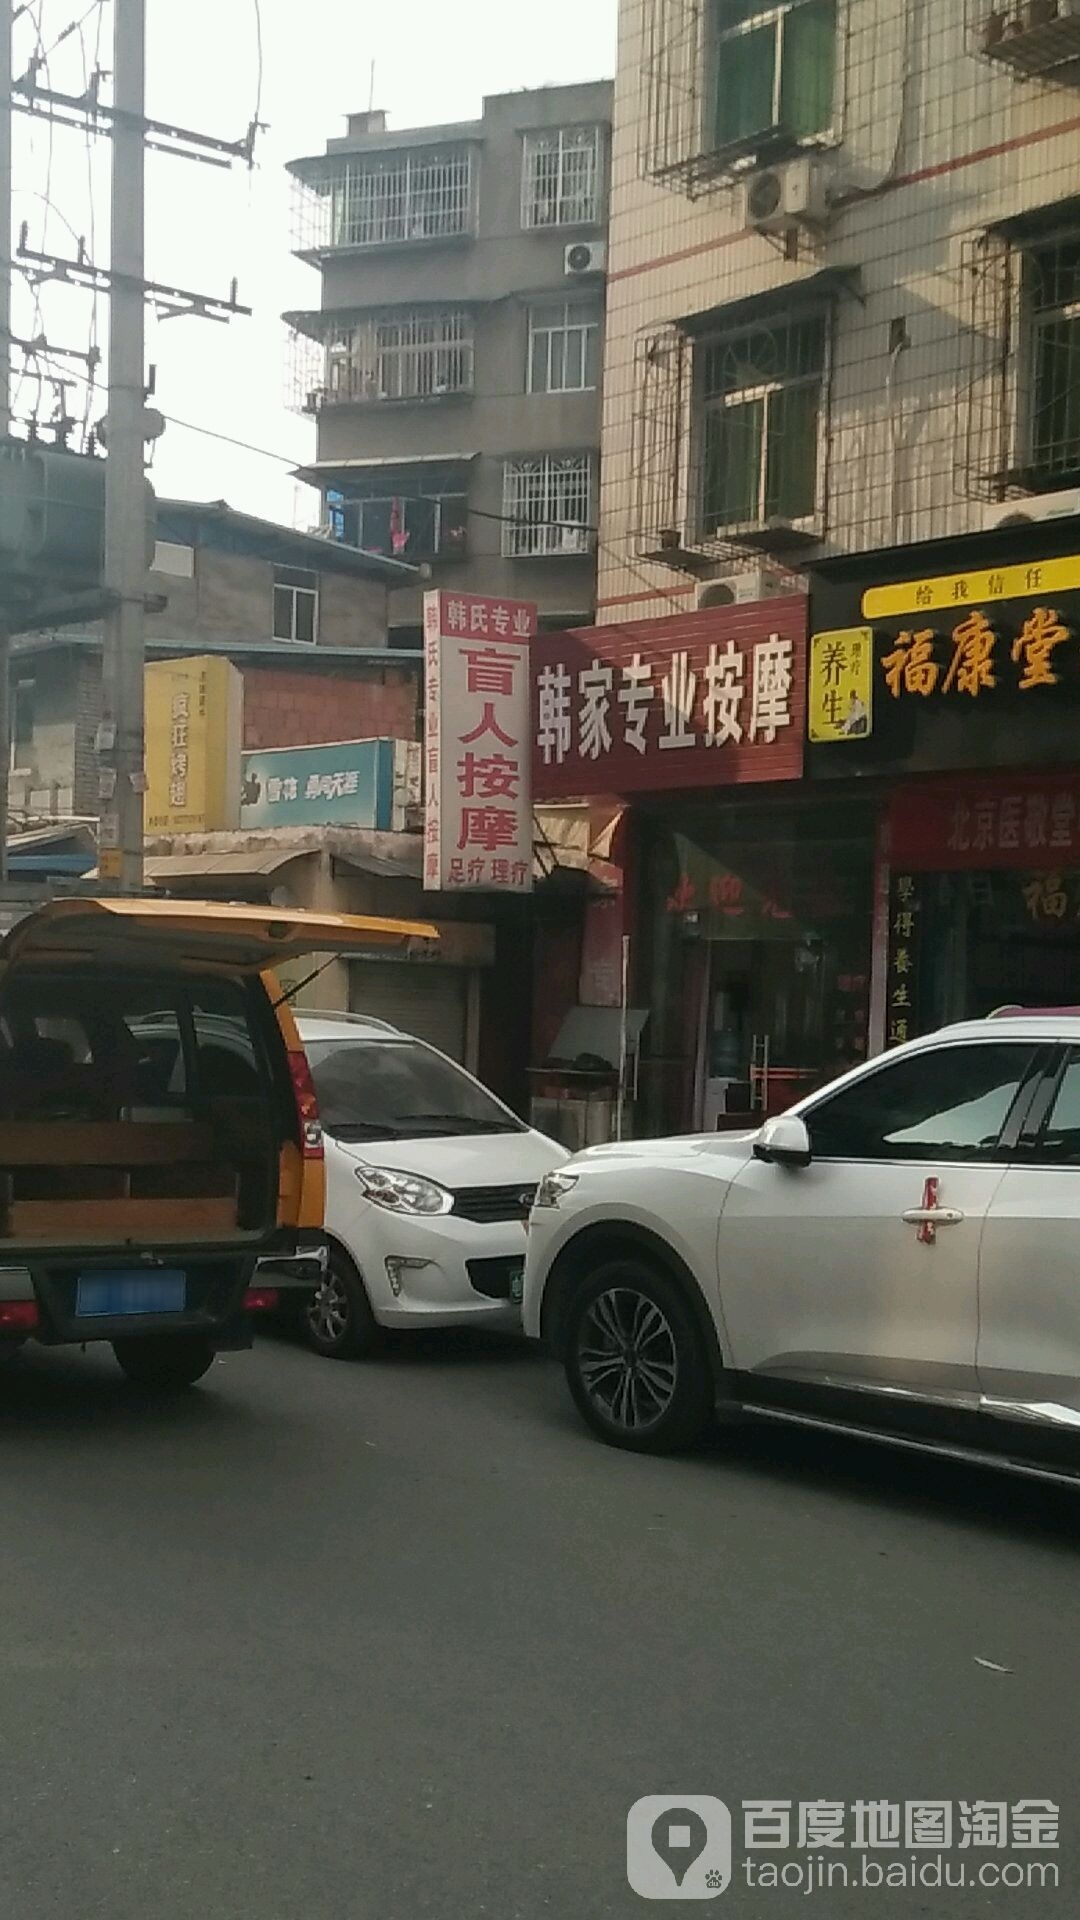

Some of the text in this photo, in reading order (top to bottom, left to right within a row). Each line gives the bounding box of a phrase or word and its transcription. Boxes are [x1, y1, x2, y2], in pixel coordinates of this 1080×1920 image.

[447, 600, 532, 639] 韩氏专业
[915, 568, 1042, 605] 给我信任
[821, 641, 848, 725] 养生
[880, 606, 1070, 698] 福康堂
[536, 632, 794, 764] 韩家专业按摩
[457, 647, 521, 852] 盲人按摩
